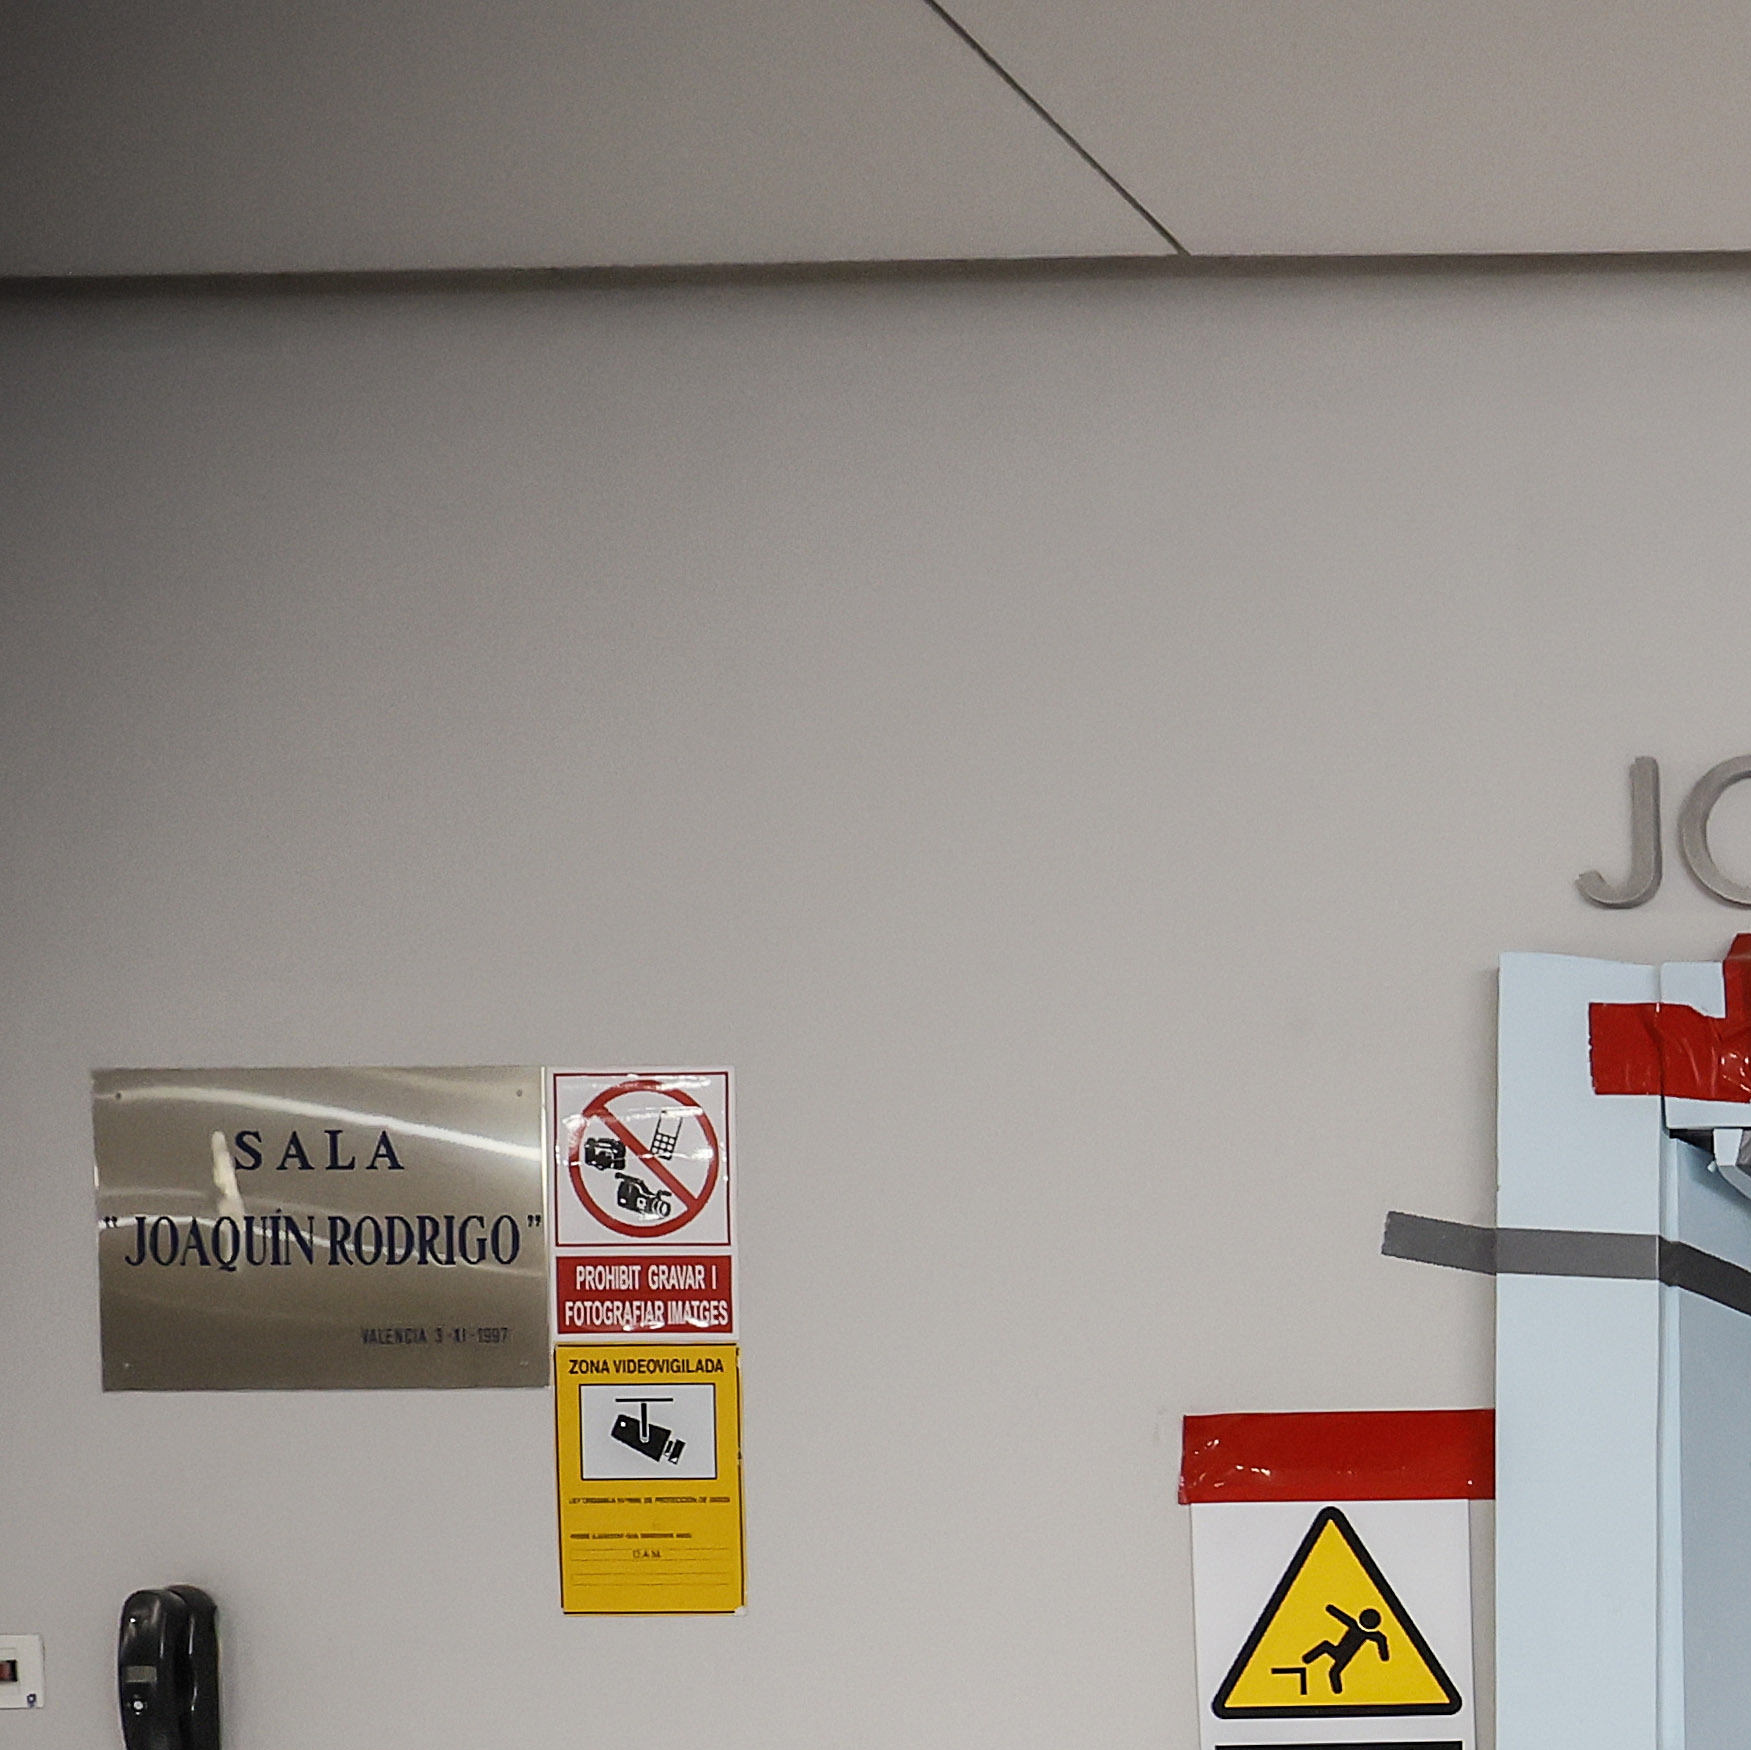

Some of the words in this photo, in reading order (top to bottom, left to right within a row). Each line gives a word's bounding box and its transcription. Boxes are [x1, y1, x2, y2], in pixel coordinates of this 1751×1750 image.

[233, 1130, 405, 1171] SALA
[576, 1264, 642, 1291] PROHIBIT
[648, 1264, 706, 1291] GRAVAR
[712, 1265, 716, 1290] I
[565, 1300, 665, 1328] FOTOGRAFIAR
[667, 1300, 730, 1327] IMATGES
[361, 1326, 428, 1345] VALENCIA
[568, 1359, 611, 1375] ZONA
[613, 1358, 725, 1375] VIDEOVIGILADA
